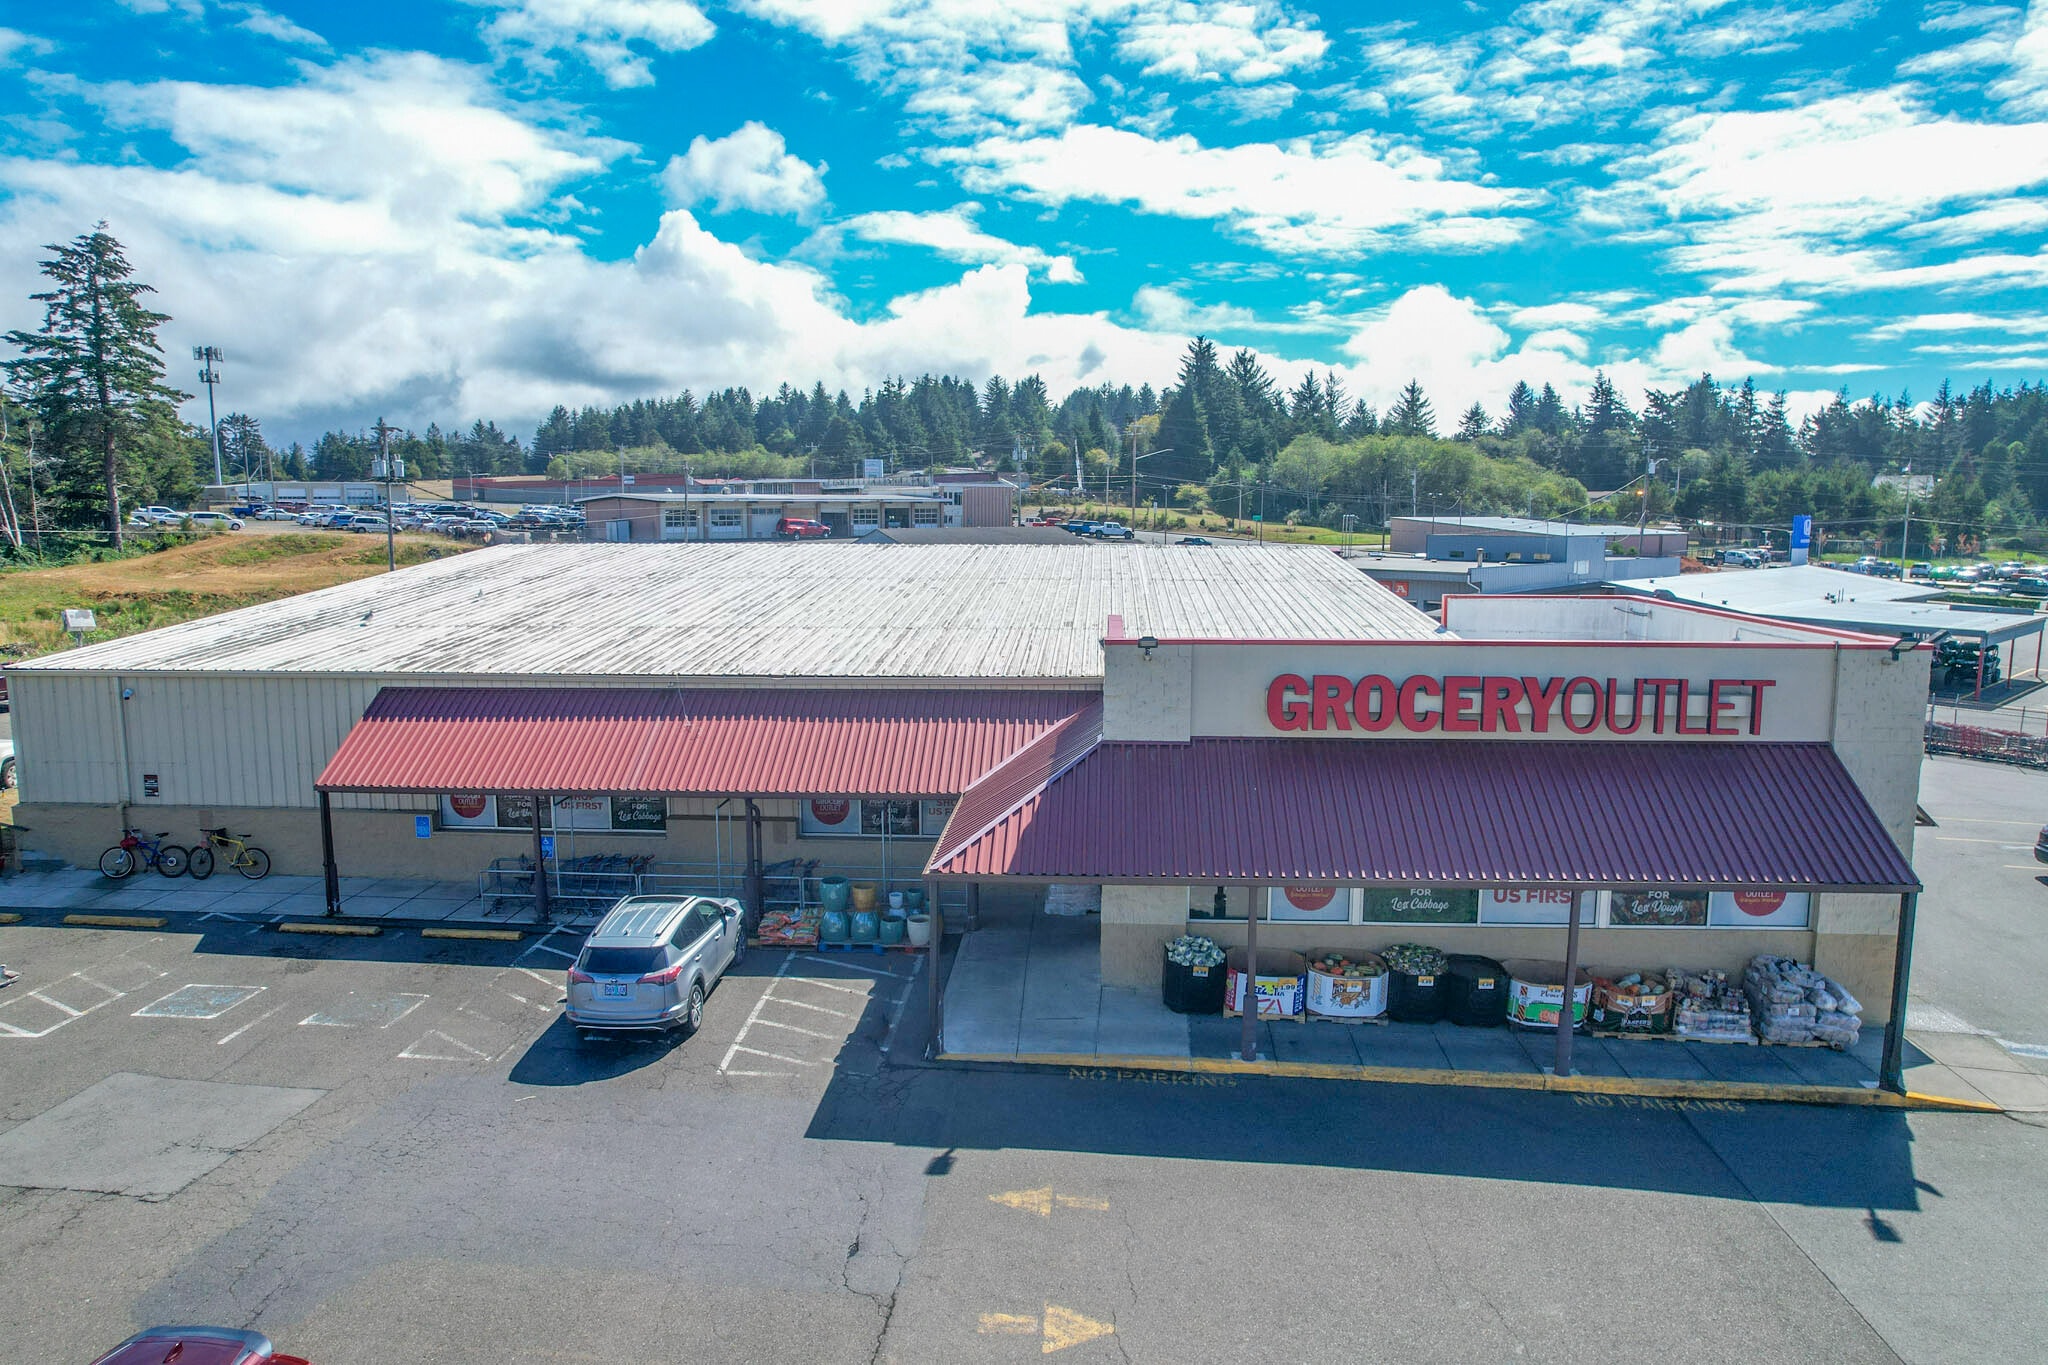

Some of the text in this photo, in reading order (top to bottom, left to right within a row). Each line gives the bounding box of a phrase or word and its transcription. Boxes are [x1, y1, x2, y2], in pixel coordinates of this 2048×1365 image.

[575, 802, 603, 810] FIRST
[928, 807, 942, 816] US
[1410, 888, 1431, 896] FOR
[1493, 888, 1572, 904] US FIRS
[1648, 890, 1670, 899] FOR
[1391, 897, 1449, 913] Less Cabbage
[1631, 899, 1684, 915] Less Dough
[1069, 1067, 1237, 1088] NO PARKING
[1575, 1094, 1747, 1113] NO PARKING
